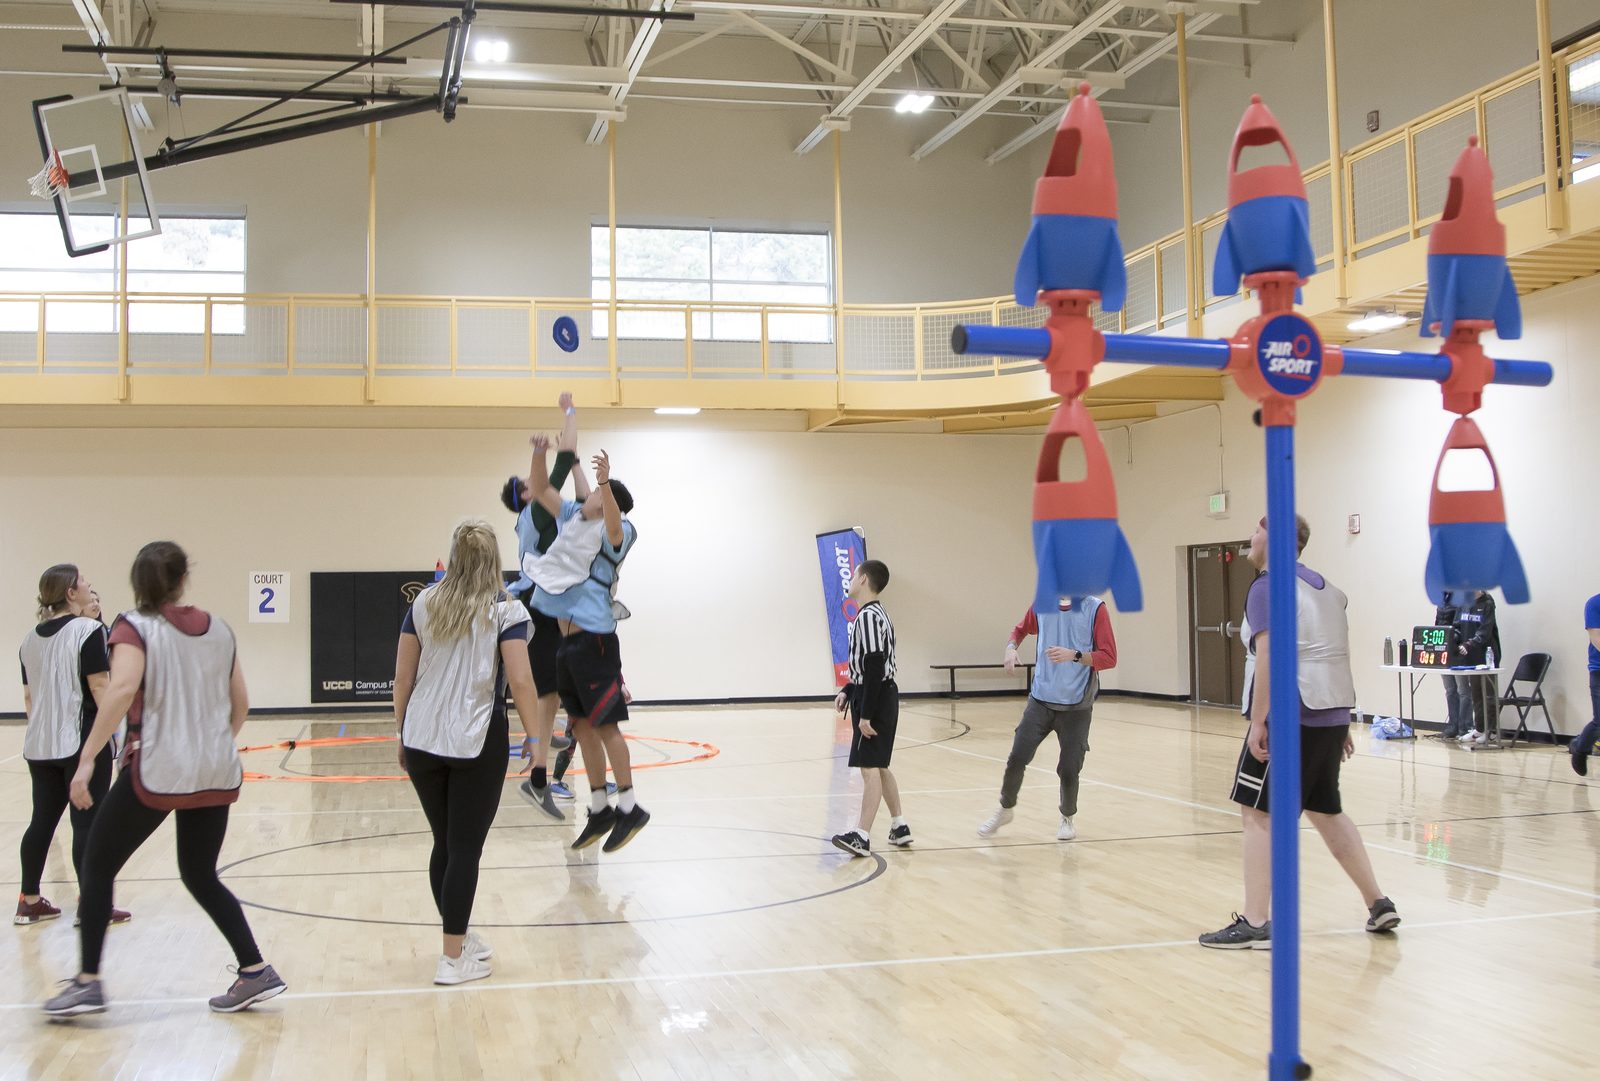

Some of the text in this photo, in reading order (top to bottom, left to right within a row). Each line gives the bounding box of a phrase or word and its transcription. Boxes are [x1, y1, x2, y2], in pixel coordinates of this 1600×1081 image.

[1268, 357, 1313, 375] SPORT
[254, 574, 284, 585] COURT
[259, 588, 275, 613] 2
[1422, 630, 1445, 644] 5:00
[355, 680, 388, 690] Campus
